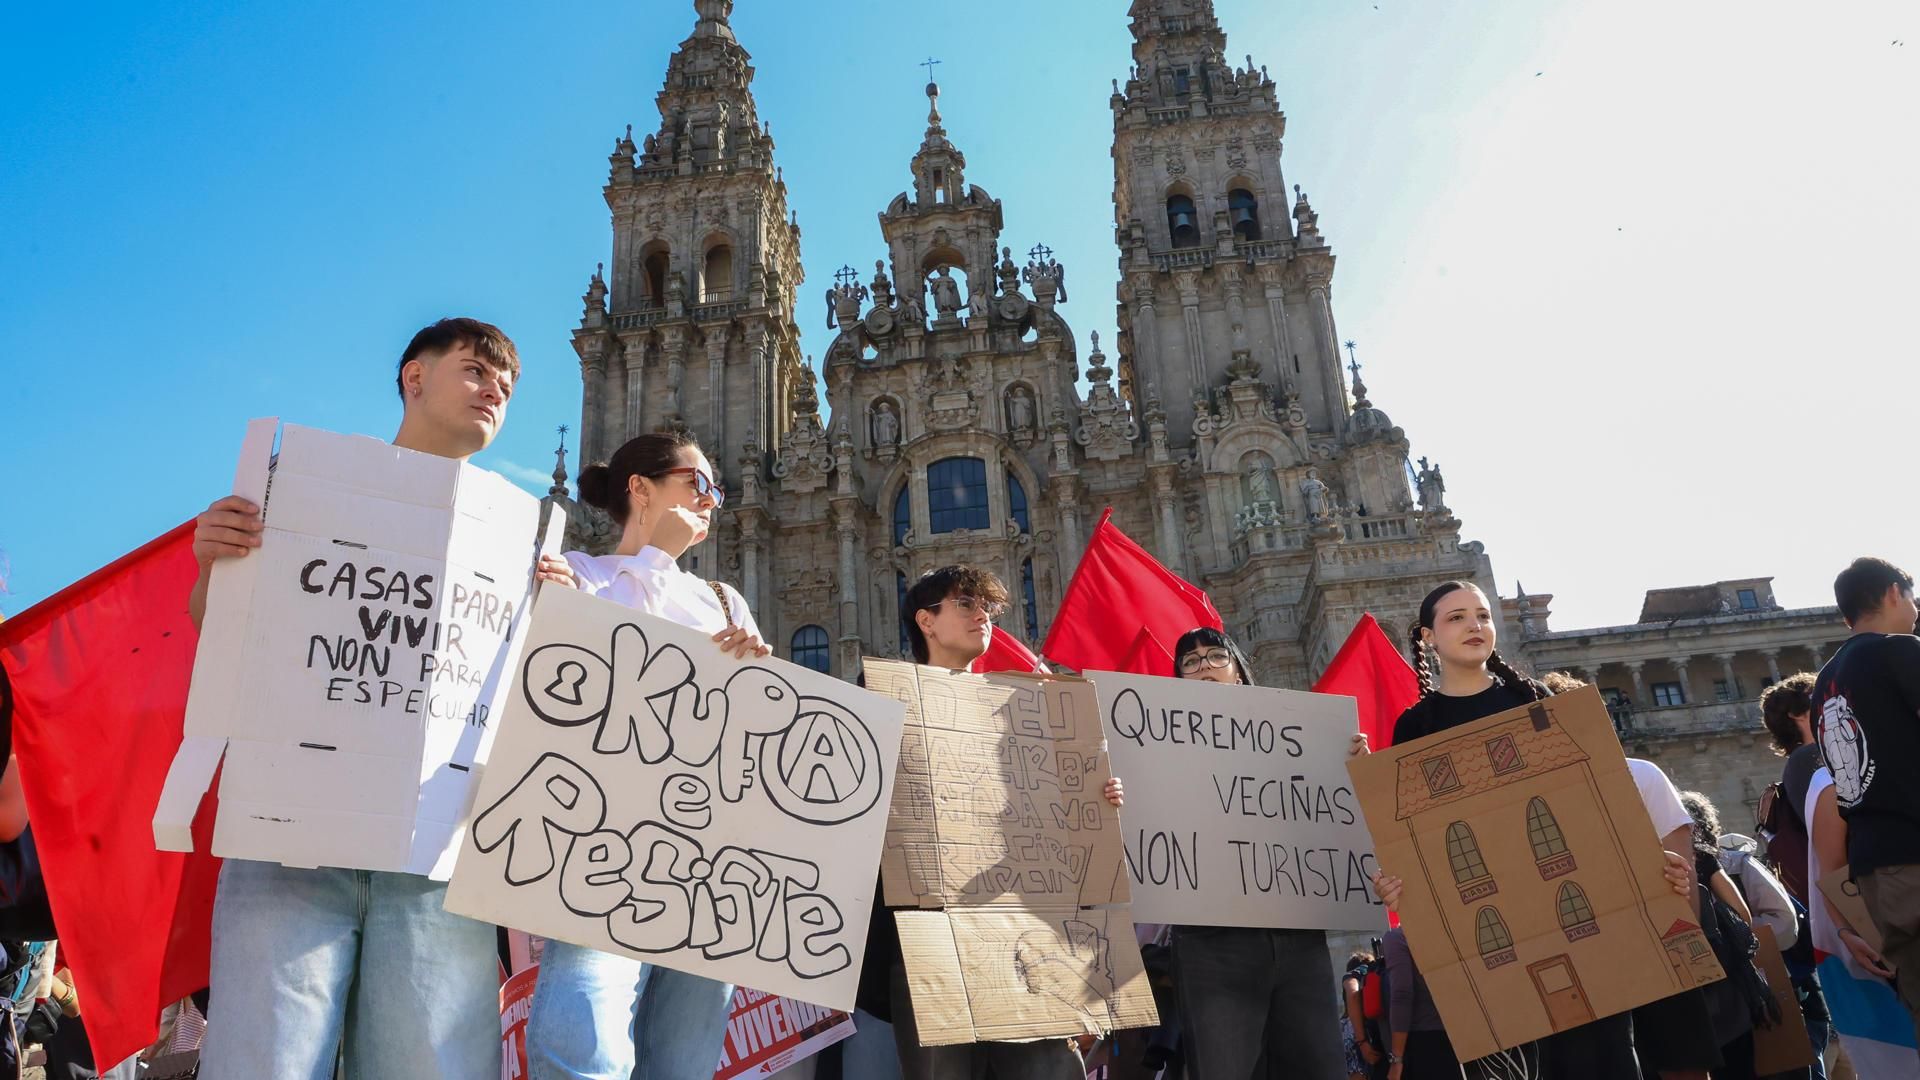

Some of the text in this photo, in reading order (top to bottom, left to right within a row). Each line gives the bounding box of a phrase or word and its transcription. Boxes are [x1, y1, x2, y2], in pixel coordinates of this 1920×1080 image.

[300, 559, 513, 642] CASAS PARA
[359, 605, 467, 660] VIVIR
[307, 634, 482, 687] NON PARA
[327, 677, 489, 730] ESPECULAR
[977, 685, 1075, 740] TEU
[1111, 688, 1303, 757] QUEREMOS
[1050, 798, 1102, 831] NO
[1213, 774, 1355, 825] VECIÑAS
[1124, 829, 1384, 905] NON TURISTAS
[727, 996, 833, 1061] VIVENDA
